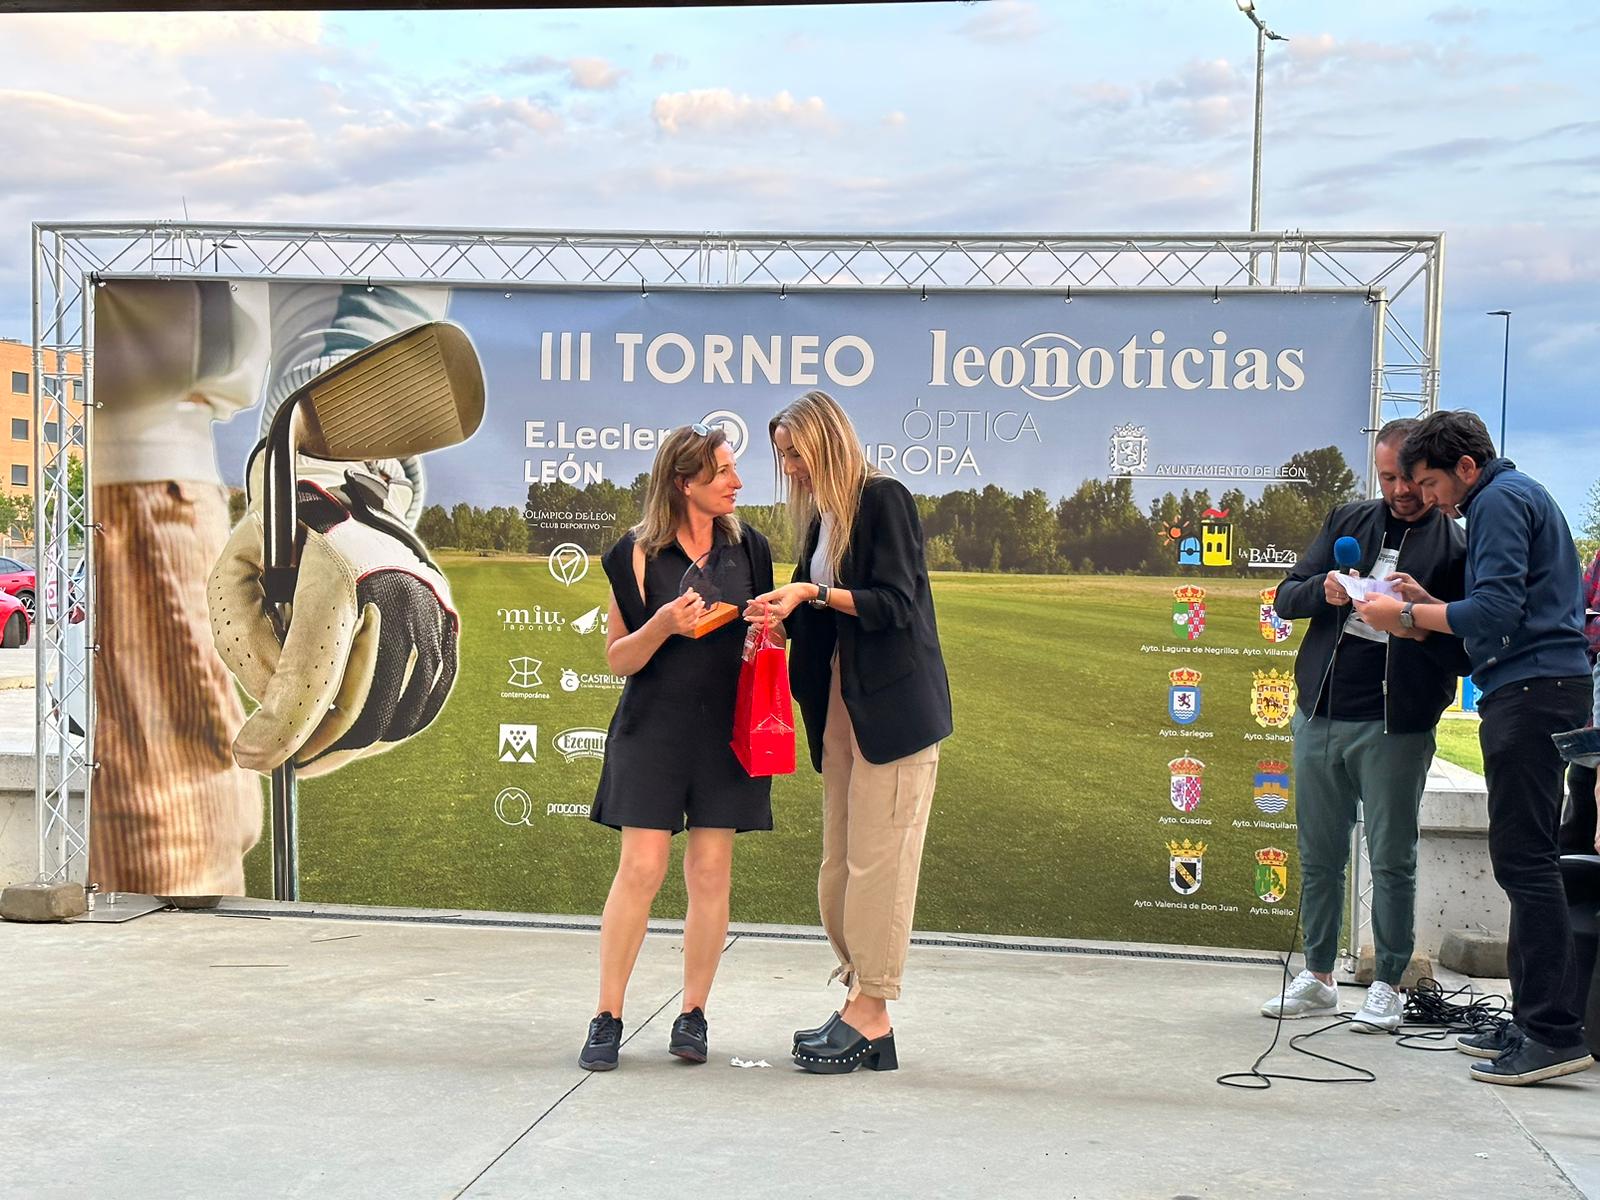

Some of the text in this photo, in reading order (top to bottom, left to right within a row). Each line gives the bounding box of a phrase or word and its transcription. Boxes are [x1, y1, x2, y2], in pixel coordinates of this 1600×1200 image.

[540, 331, 875, 387] III TORNEO
[928, 329, 1305, 392] leonoticias
[902, 398, 1042, 442] ÓPTICA
[525, 420, 672, 451] E.Lecler
[866, 443, 982, 475] ROPA
[524, 453, 603, 485] LEÓN
[1155, 464, 1307, 478] AYUNTAMIENTO DE LEÓN
[525, 509, 616, 521] OLÍMPICO DE LEÓN
[560, 522, 600, 530] DEPORTIVO
[497, 604, 565, 625] miu
[1141, 645, 1160, 653] Ayto.
[1162, 645, 1190, 654] Laguna
[1204, 647, 1239, 656] Negrillos
[1242, 648, 1299, 657] Ayto. Villamañ
[500, 691, 550, 700] contemporánea
[1159, 729, 1214, 739] Ayto. Sariegos
[1244, 732, 1264, 741] Ayto.
[563, 734, 604, 751] Ezequi
[1158, 816, 1212, 826] Ayto. Cuadros
[1232, 819, 1298, 830] Ayto. Villaquilam
[1134, 899, 1153, 909] Ayto.
[1155, 901, 1187, 911] Valencia
[1201, 904, 1217, 912] Don
[1219, 904, 1238, 913] Juan
[1250, 906, 1294, 917] Ayto. Riello
